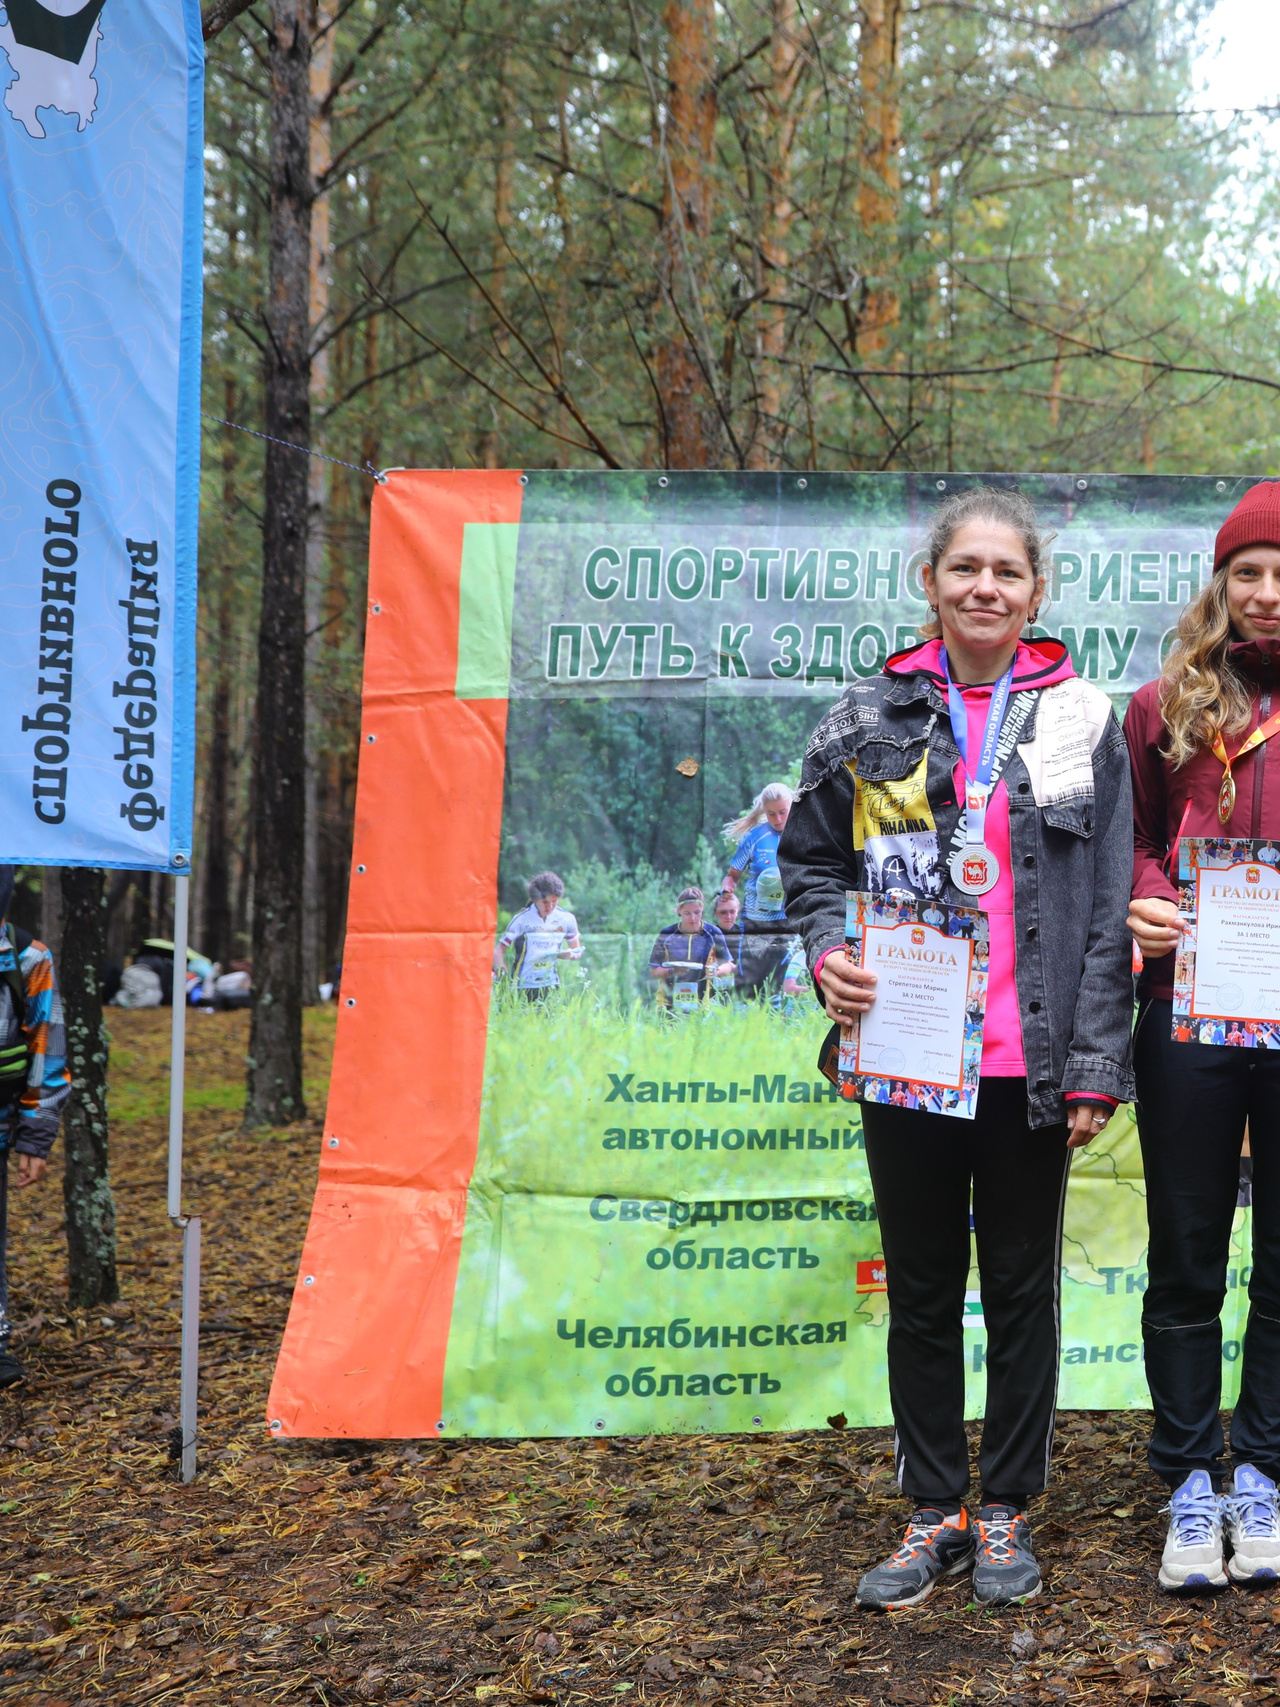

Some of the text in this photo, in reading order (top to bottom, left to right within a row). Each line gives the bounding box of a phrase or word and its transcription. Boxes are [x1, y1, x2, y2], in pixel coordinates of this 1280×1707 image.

[583, 545, 933, 602] СПОРТИВНО
[546, 622, 695, 680] ПУТЬ
[717, 623, 753, 679] К
[828, 717, 855, 734] YOUR
[999, 705, 1021, 744] LIMITED
[1004, 710, 1027, 750] EDITION
[981, 723, 997, 766] ОБЛАСТЬ
[880, 818, 930, 836] RIHANNA
[876, 942, 958, 966] ГРАМОТА
[888, 979, 948, 993] Стрепетова Марина
[914, 994, 935, 1002] МЕСТО
[604, 1073, 856, 1104] Ханты-Ман
[602, 1119, 867, 1151] автономный
[646, 1239, 821, 1271] область
[556, 1317, 848, 1350] Челябинская
[605, 1366, 782, 1399] область
